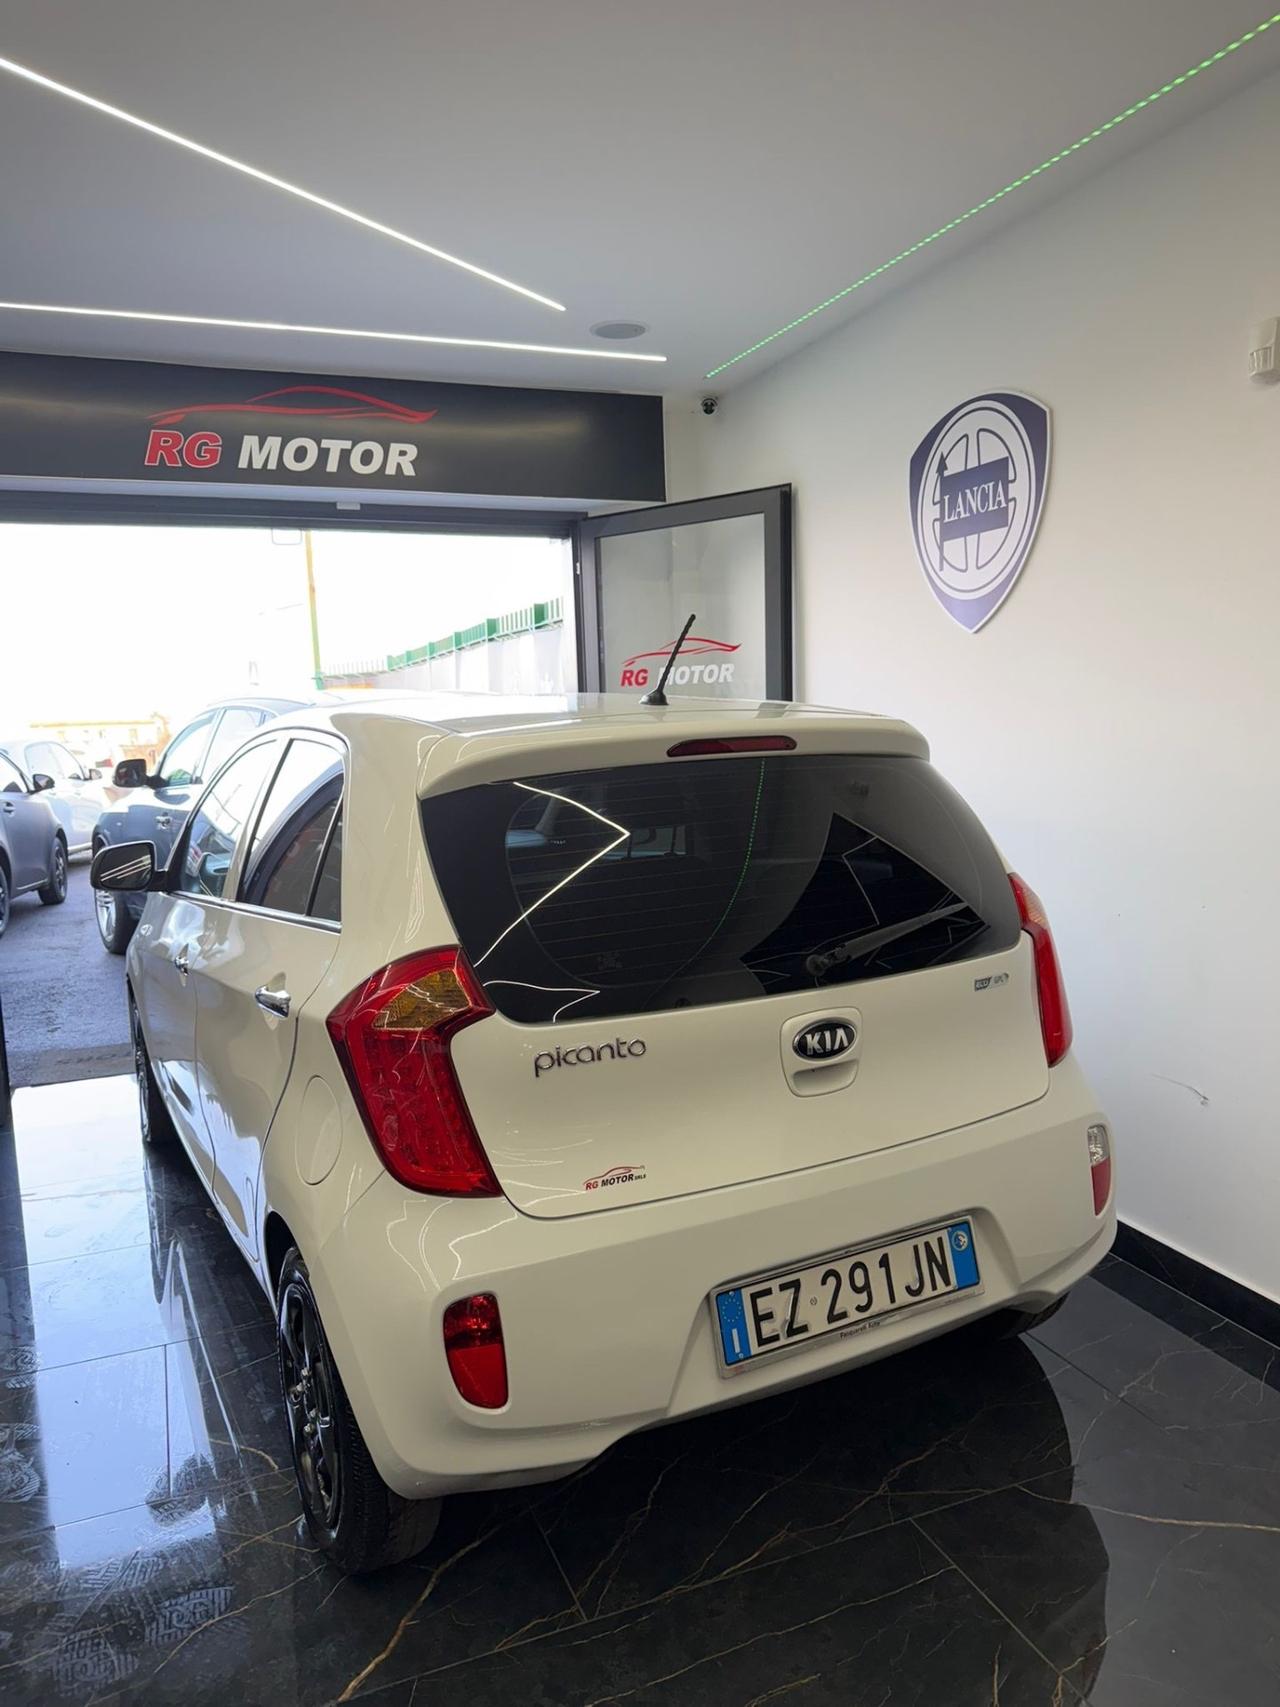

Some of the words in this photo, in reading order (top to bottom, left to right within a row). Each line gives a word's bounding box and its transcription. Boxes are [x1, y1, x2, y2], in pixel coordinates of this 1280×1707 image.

[144, 429, 223, 468] RG
[237, 434, 418, 476] MOTOR
[943, 479, 1007, 523] LANCIA
[620, 668, 648, 687] RG
[534, 1037, 647, 1078] picanto
[805, 1027, 849, 1055] KIA
[585, 1181, 599, 1191] RG
[601, 1173, 634, 1187] MOTOR
[750, 1278, 809, 1348] EZ
[820, 1252, 896, 1325] 291
[905, 1236, 952, 1298] JN
